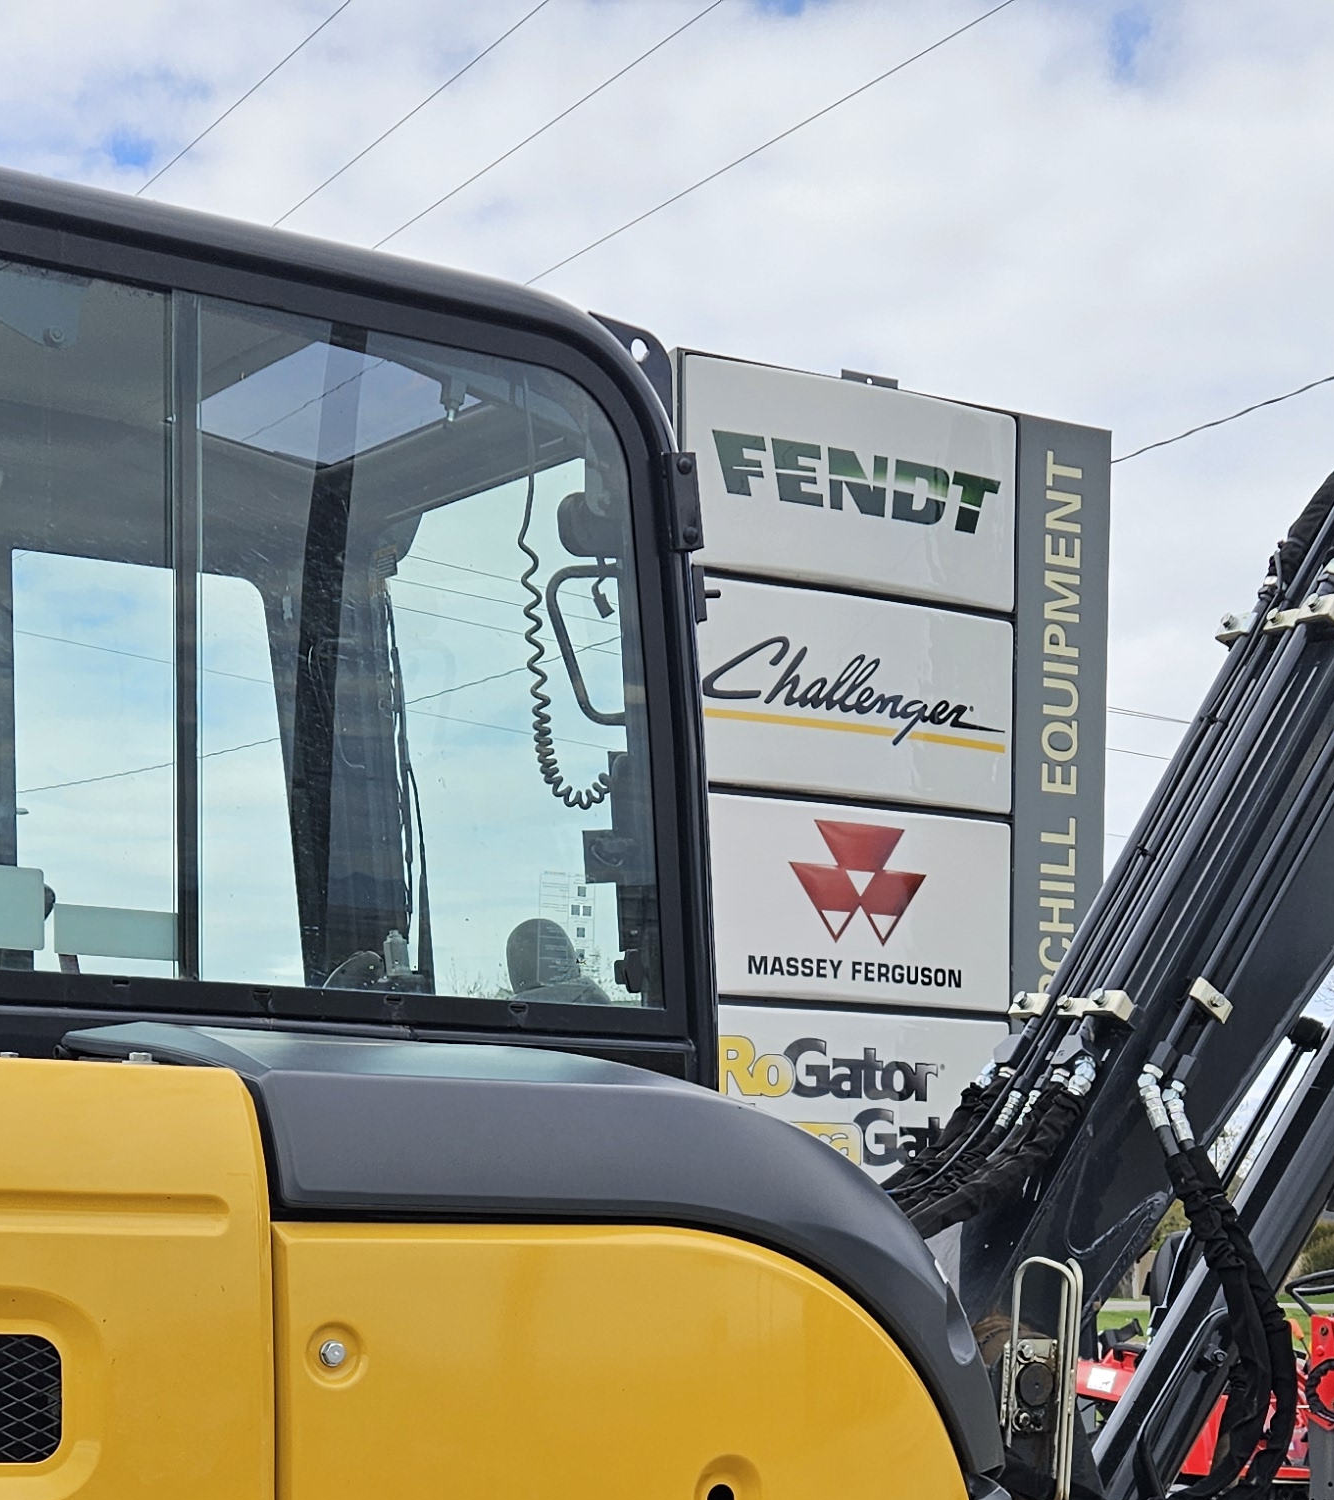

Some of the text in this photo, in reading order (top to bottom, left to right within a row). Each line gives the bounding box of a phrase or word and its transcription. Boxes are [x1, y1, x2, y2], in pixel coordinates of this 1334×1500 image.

[711, 428, 1002, 535] FENDT
[1040, 450, 1084, 795] EQUIPMENT
[702, 636, 1006, 746] Challenger
[748, 954, 962, 989] MASSEY FERGUSON
[719, 1034, 939, 1102] RoGator
